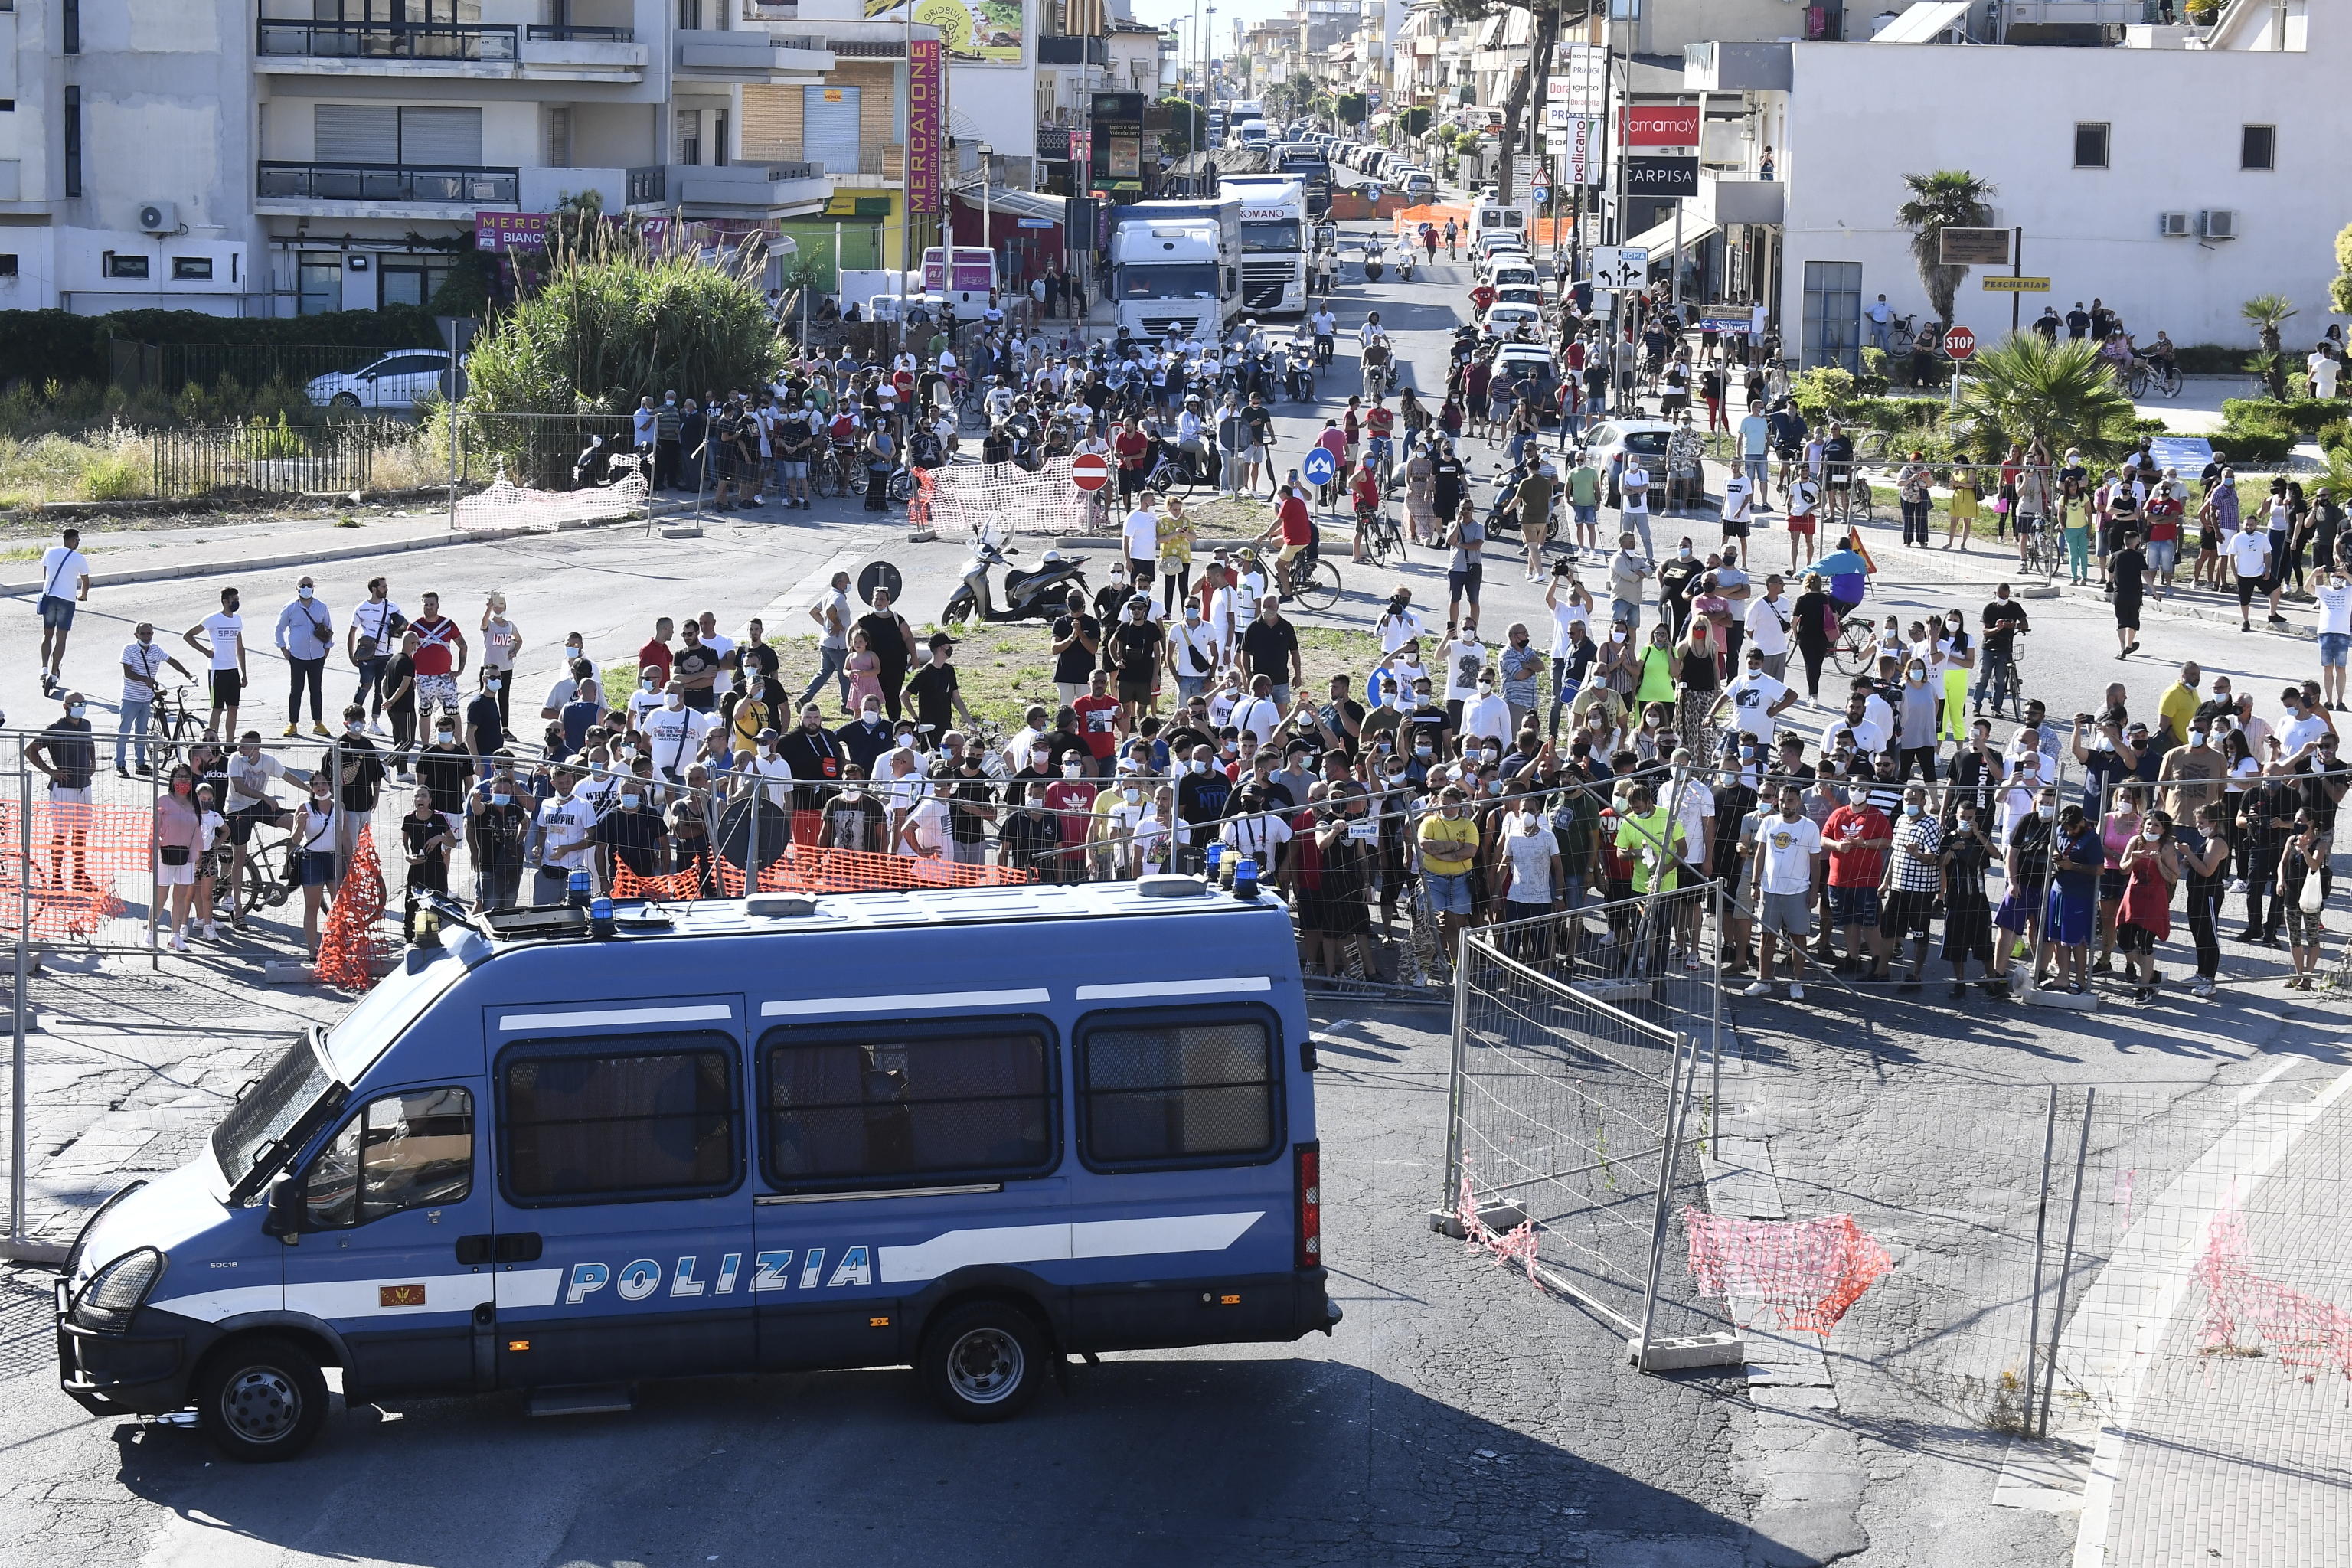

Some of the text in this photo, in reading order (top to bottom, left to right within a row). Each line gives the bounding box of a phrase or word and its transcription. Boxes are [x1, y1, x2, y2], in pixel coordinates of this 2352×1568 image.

[923, 6, 962, 21] GRIDBUN
[931, 112, 936, 125] LA
[911, 43, 926, 212] MERCATONE
[1571, 120, 1586, 182] pellicano
[1626, 169, 1692, 183] CARPISA
[503, 233, 544, 243] BIANC
[1984, 280, 2040, 289] PESCHERIA
[1716, 320, 1749, 332] Sakura
[1946, 336, 1974, 349] STOP
[492, 633, 511, 645] LOVE
[1736, 688, 1762, 706] MTV
[204, 770, 227, 779] idas
[1978, 775, 1988, 787] DO
[1976, 789, 1986, 809] JUST
[565, 1245, 872, 1305] POLIZIA
